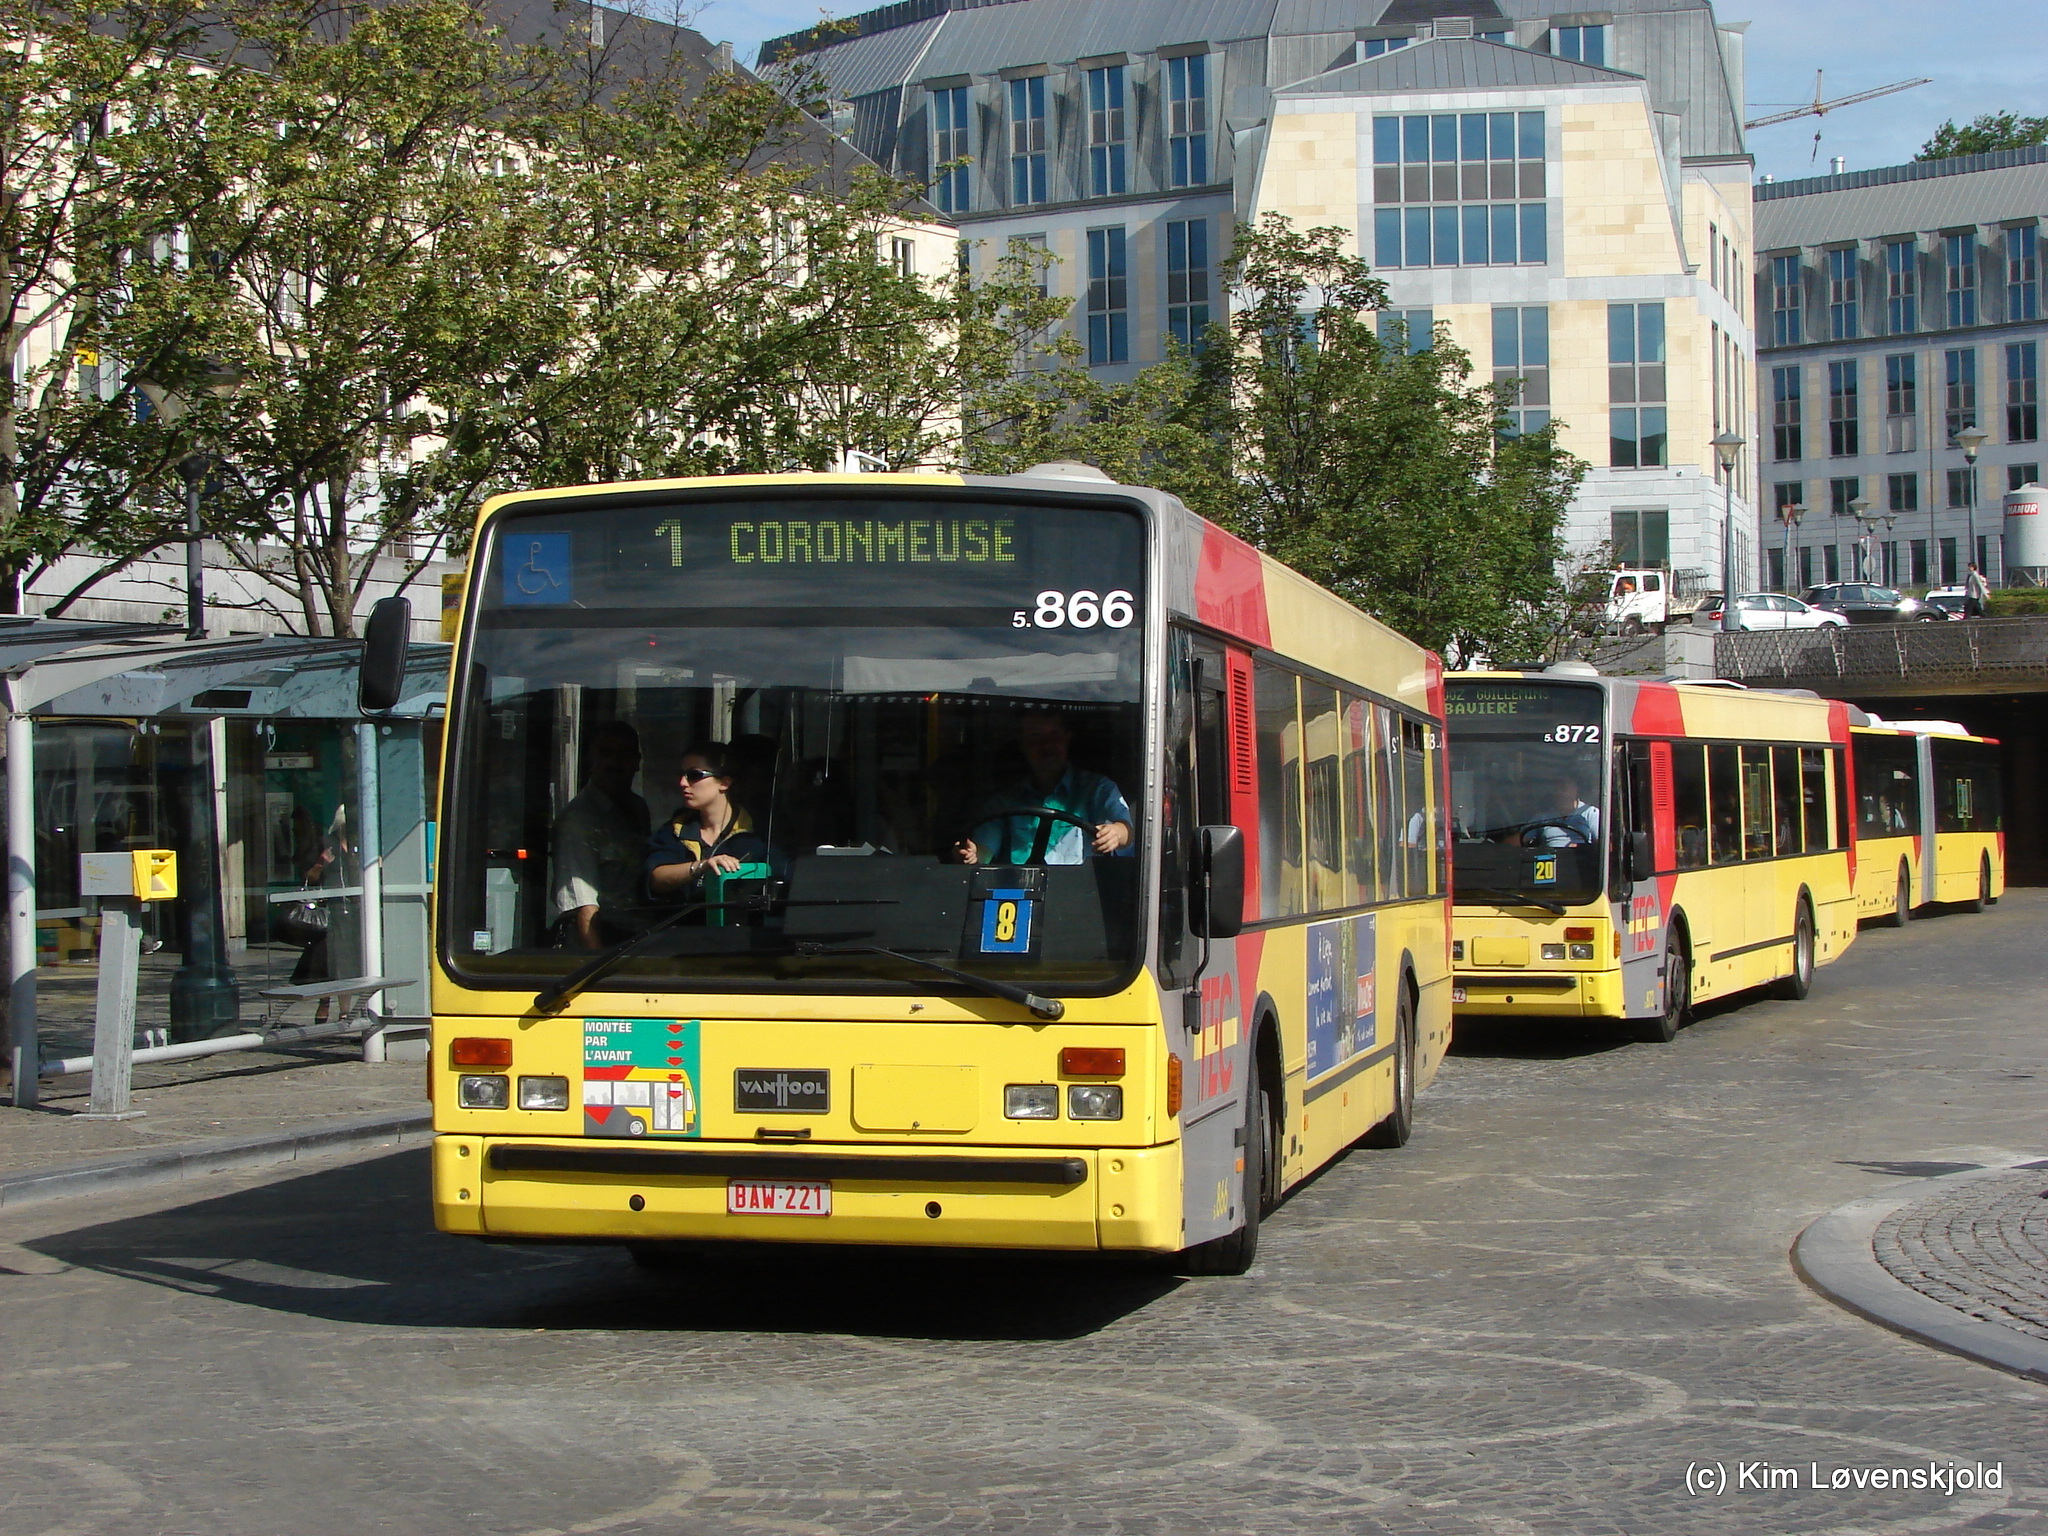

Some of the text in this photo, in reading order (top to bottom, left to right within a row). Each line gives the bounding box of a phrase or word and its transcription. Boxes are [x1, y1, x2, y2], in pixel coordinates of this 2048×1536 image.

[2008, 504, 2038, 514] NAMUR
[655, 519, 1017, 567] 1 CORONMEUSE
[1445, 702, 1518, 715] BAVIERE
[1536, 861, 1553, 880] 20
[997, 901, 1016, 941] 8
[1633, 894, 1655, 954] TEC
[585, 1020, 633, 1033] MONTÉE
[585, 1036, 608, 1047] PAR
[1201, 971, 1233, 1101] TEC
[585, 1050, 633, 1061] L'AVANT
